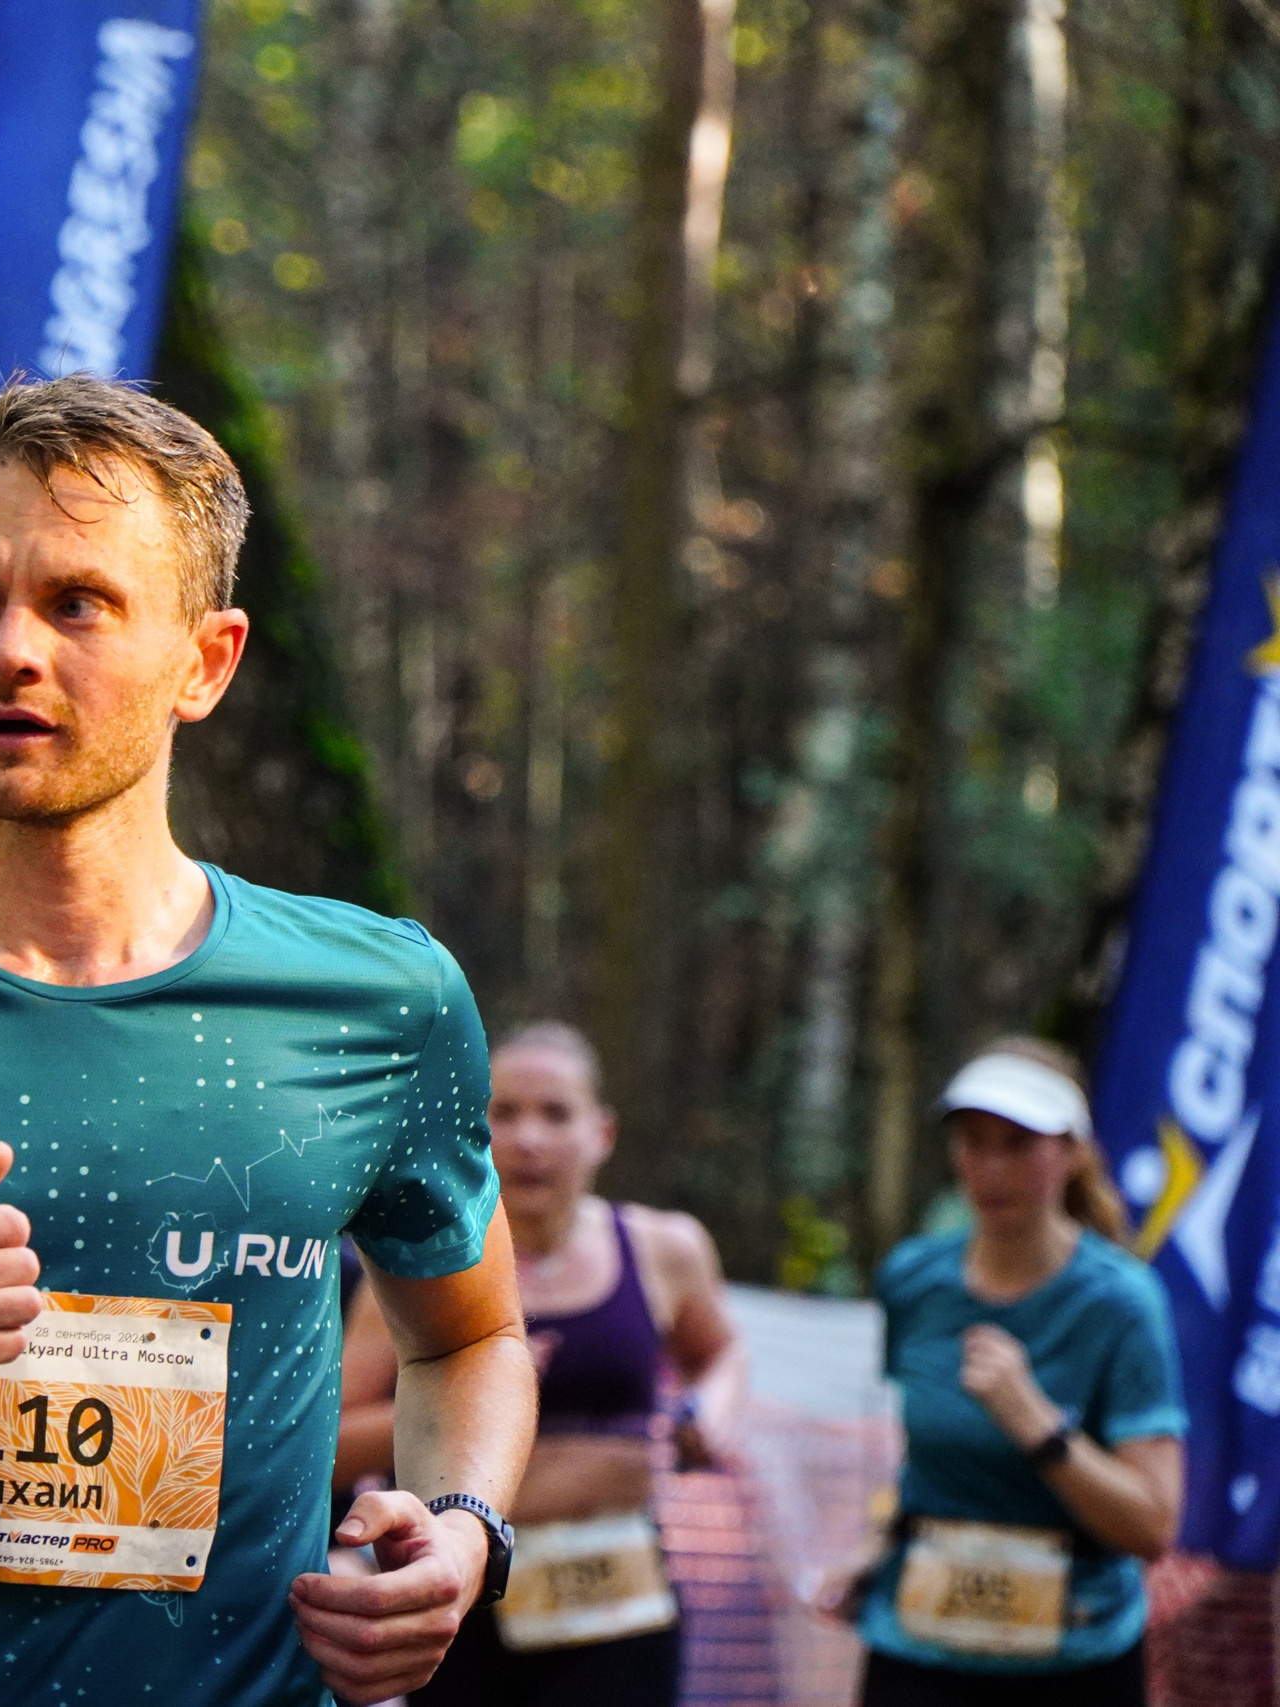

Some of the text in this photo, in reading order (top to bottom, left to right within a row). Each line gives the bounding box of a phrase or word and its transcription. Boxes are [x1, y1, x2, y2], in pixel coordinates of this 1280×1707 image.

[165, 1231, 329, 1279] U RUN
[35, 1327, 146, 1344] 28 сентября 2024
[83, 1346, 128, 1361] Ultra
[137, 1350, 195, 1366] Moscow
[72, 1537, 115, 1552] PRO
